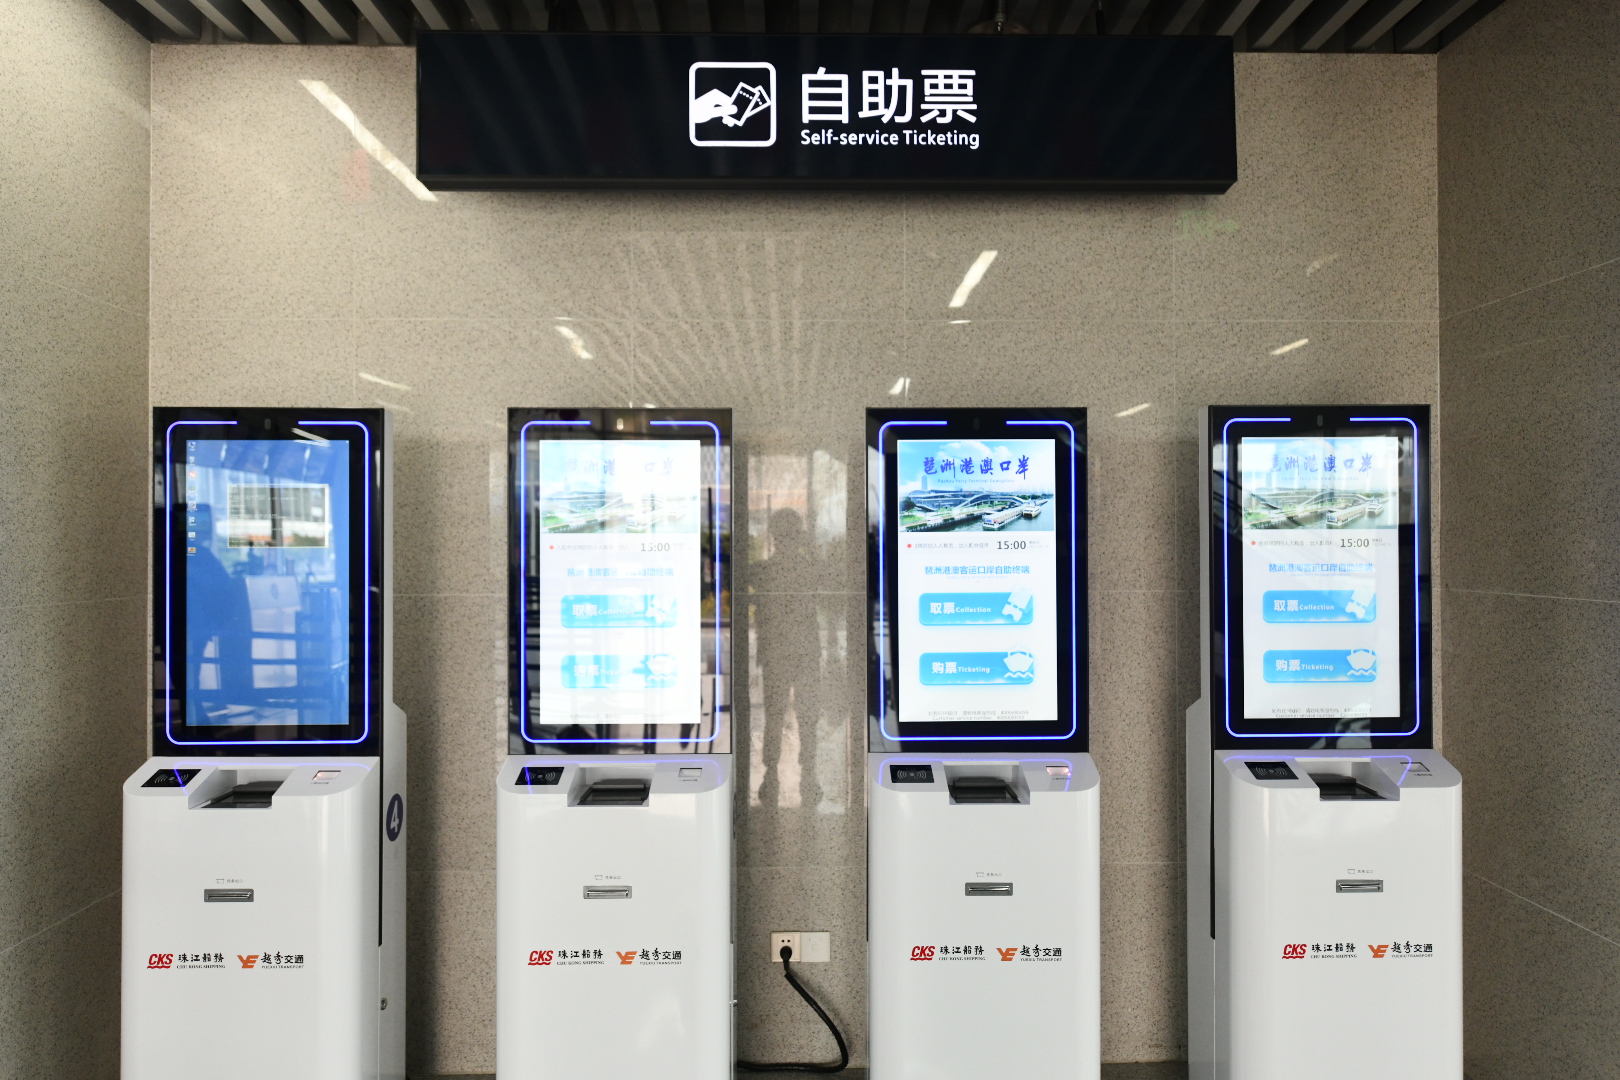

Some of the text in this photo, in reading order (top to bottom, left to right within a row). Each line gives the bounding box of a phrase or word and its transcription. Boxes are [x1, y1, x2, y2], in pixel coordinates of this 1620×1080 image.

[801, 67, 978, 124] 自助票
[801, 129, 980, 150] Self-service Ticketing
[640, 543, 670, 552] 15:00
[996, 540, 1026, 550] 15:00
[1340, 538, 1370, 548] 15:00
[930, 602, 956, 614] 取票
[1274, 600, 1298, 612] 取票
[932, 662, 957, 674] 购票
[1276, 659, 1300, 671] 购票
[390, 800, 400, 833] 4
[912, 946, 936, 957] CKS
[1020, 944, 1062, 957] 越秀交通
[1283, 944, 1307, 955] CKS
[1391, 941, 1433, 953] 越秀交通
[149, 954, 174, 965] CKS
[261, 951, 304, 964] 越秀交通
[529, 950, 553, 961] CKS
[639, 948, 682, 960] 越秀交通
